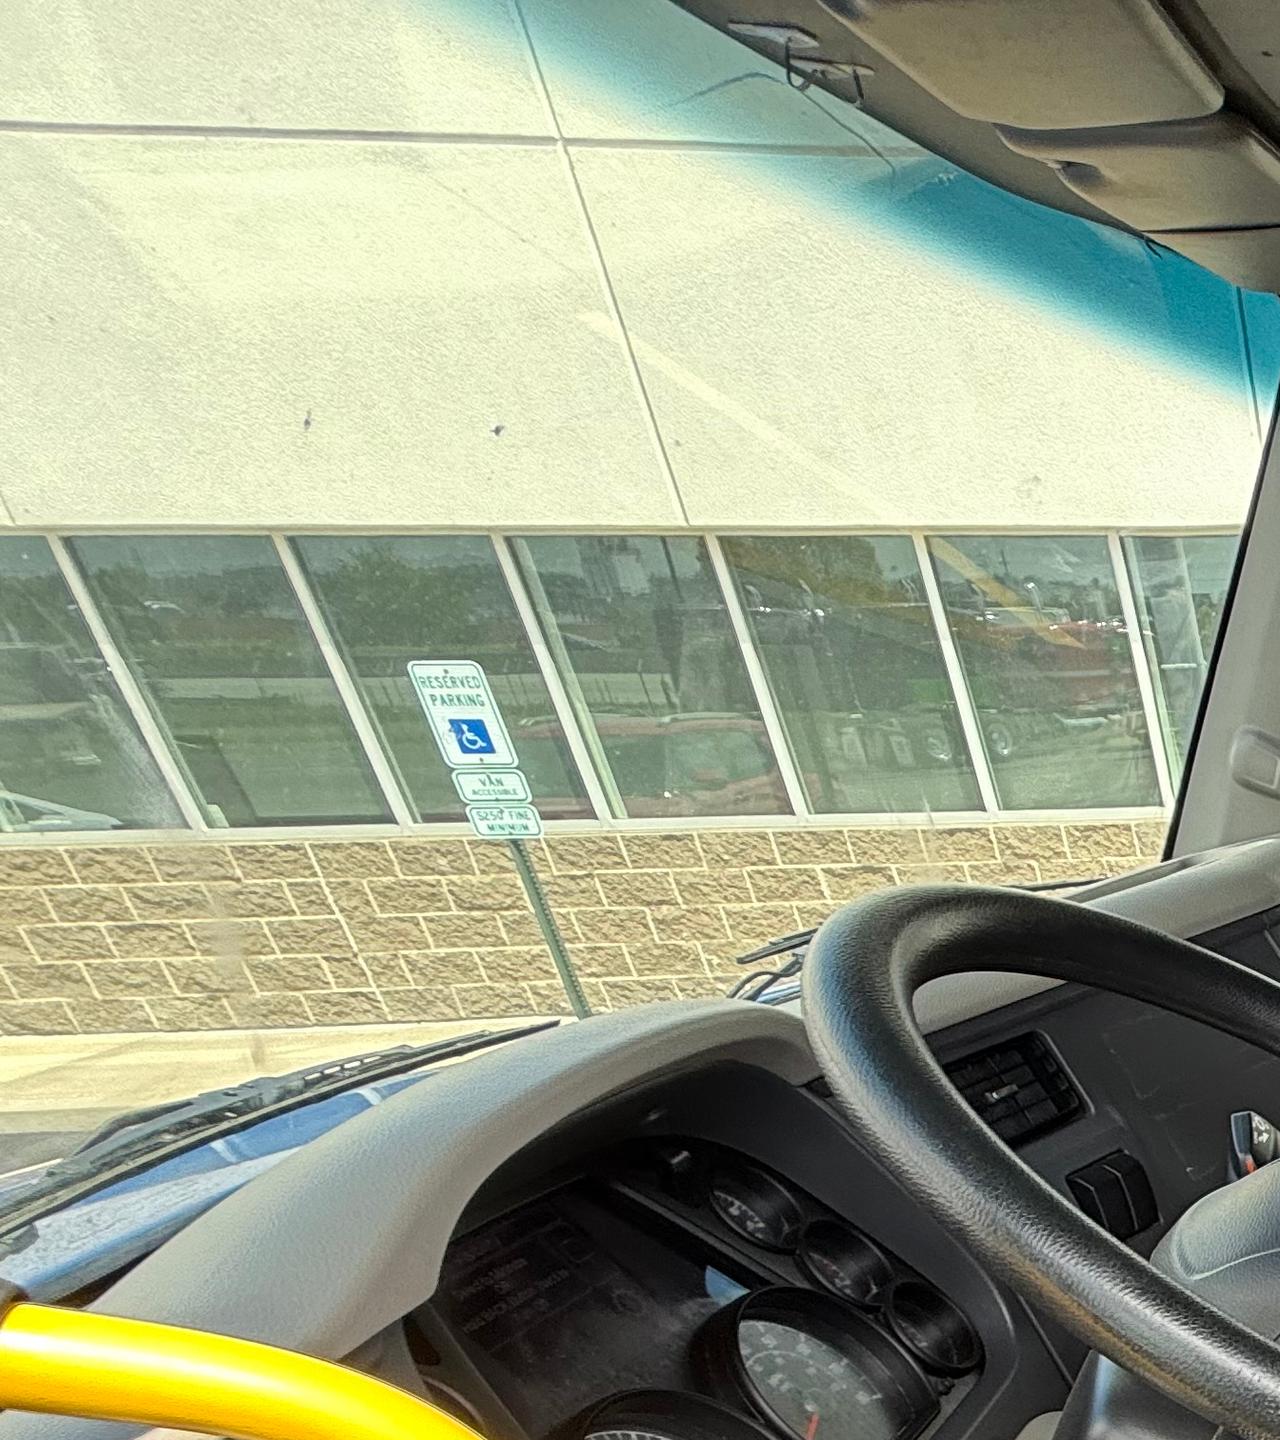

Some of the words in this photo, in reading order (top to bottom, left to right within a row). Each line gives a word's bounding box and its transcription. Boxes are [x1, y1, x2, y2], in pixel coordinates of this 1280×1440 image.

[418, 675, 481, 690] RESERVED
[430, 693, 486, 709] PARKING
[478, 776, 504, 787] VAN
[509, 810, 531, 821] FINE
[487, 823, 530, 832] MINIMUM
